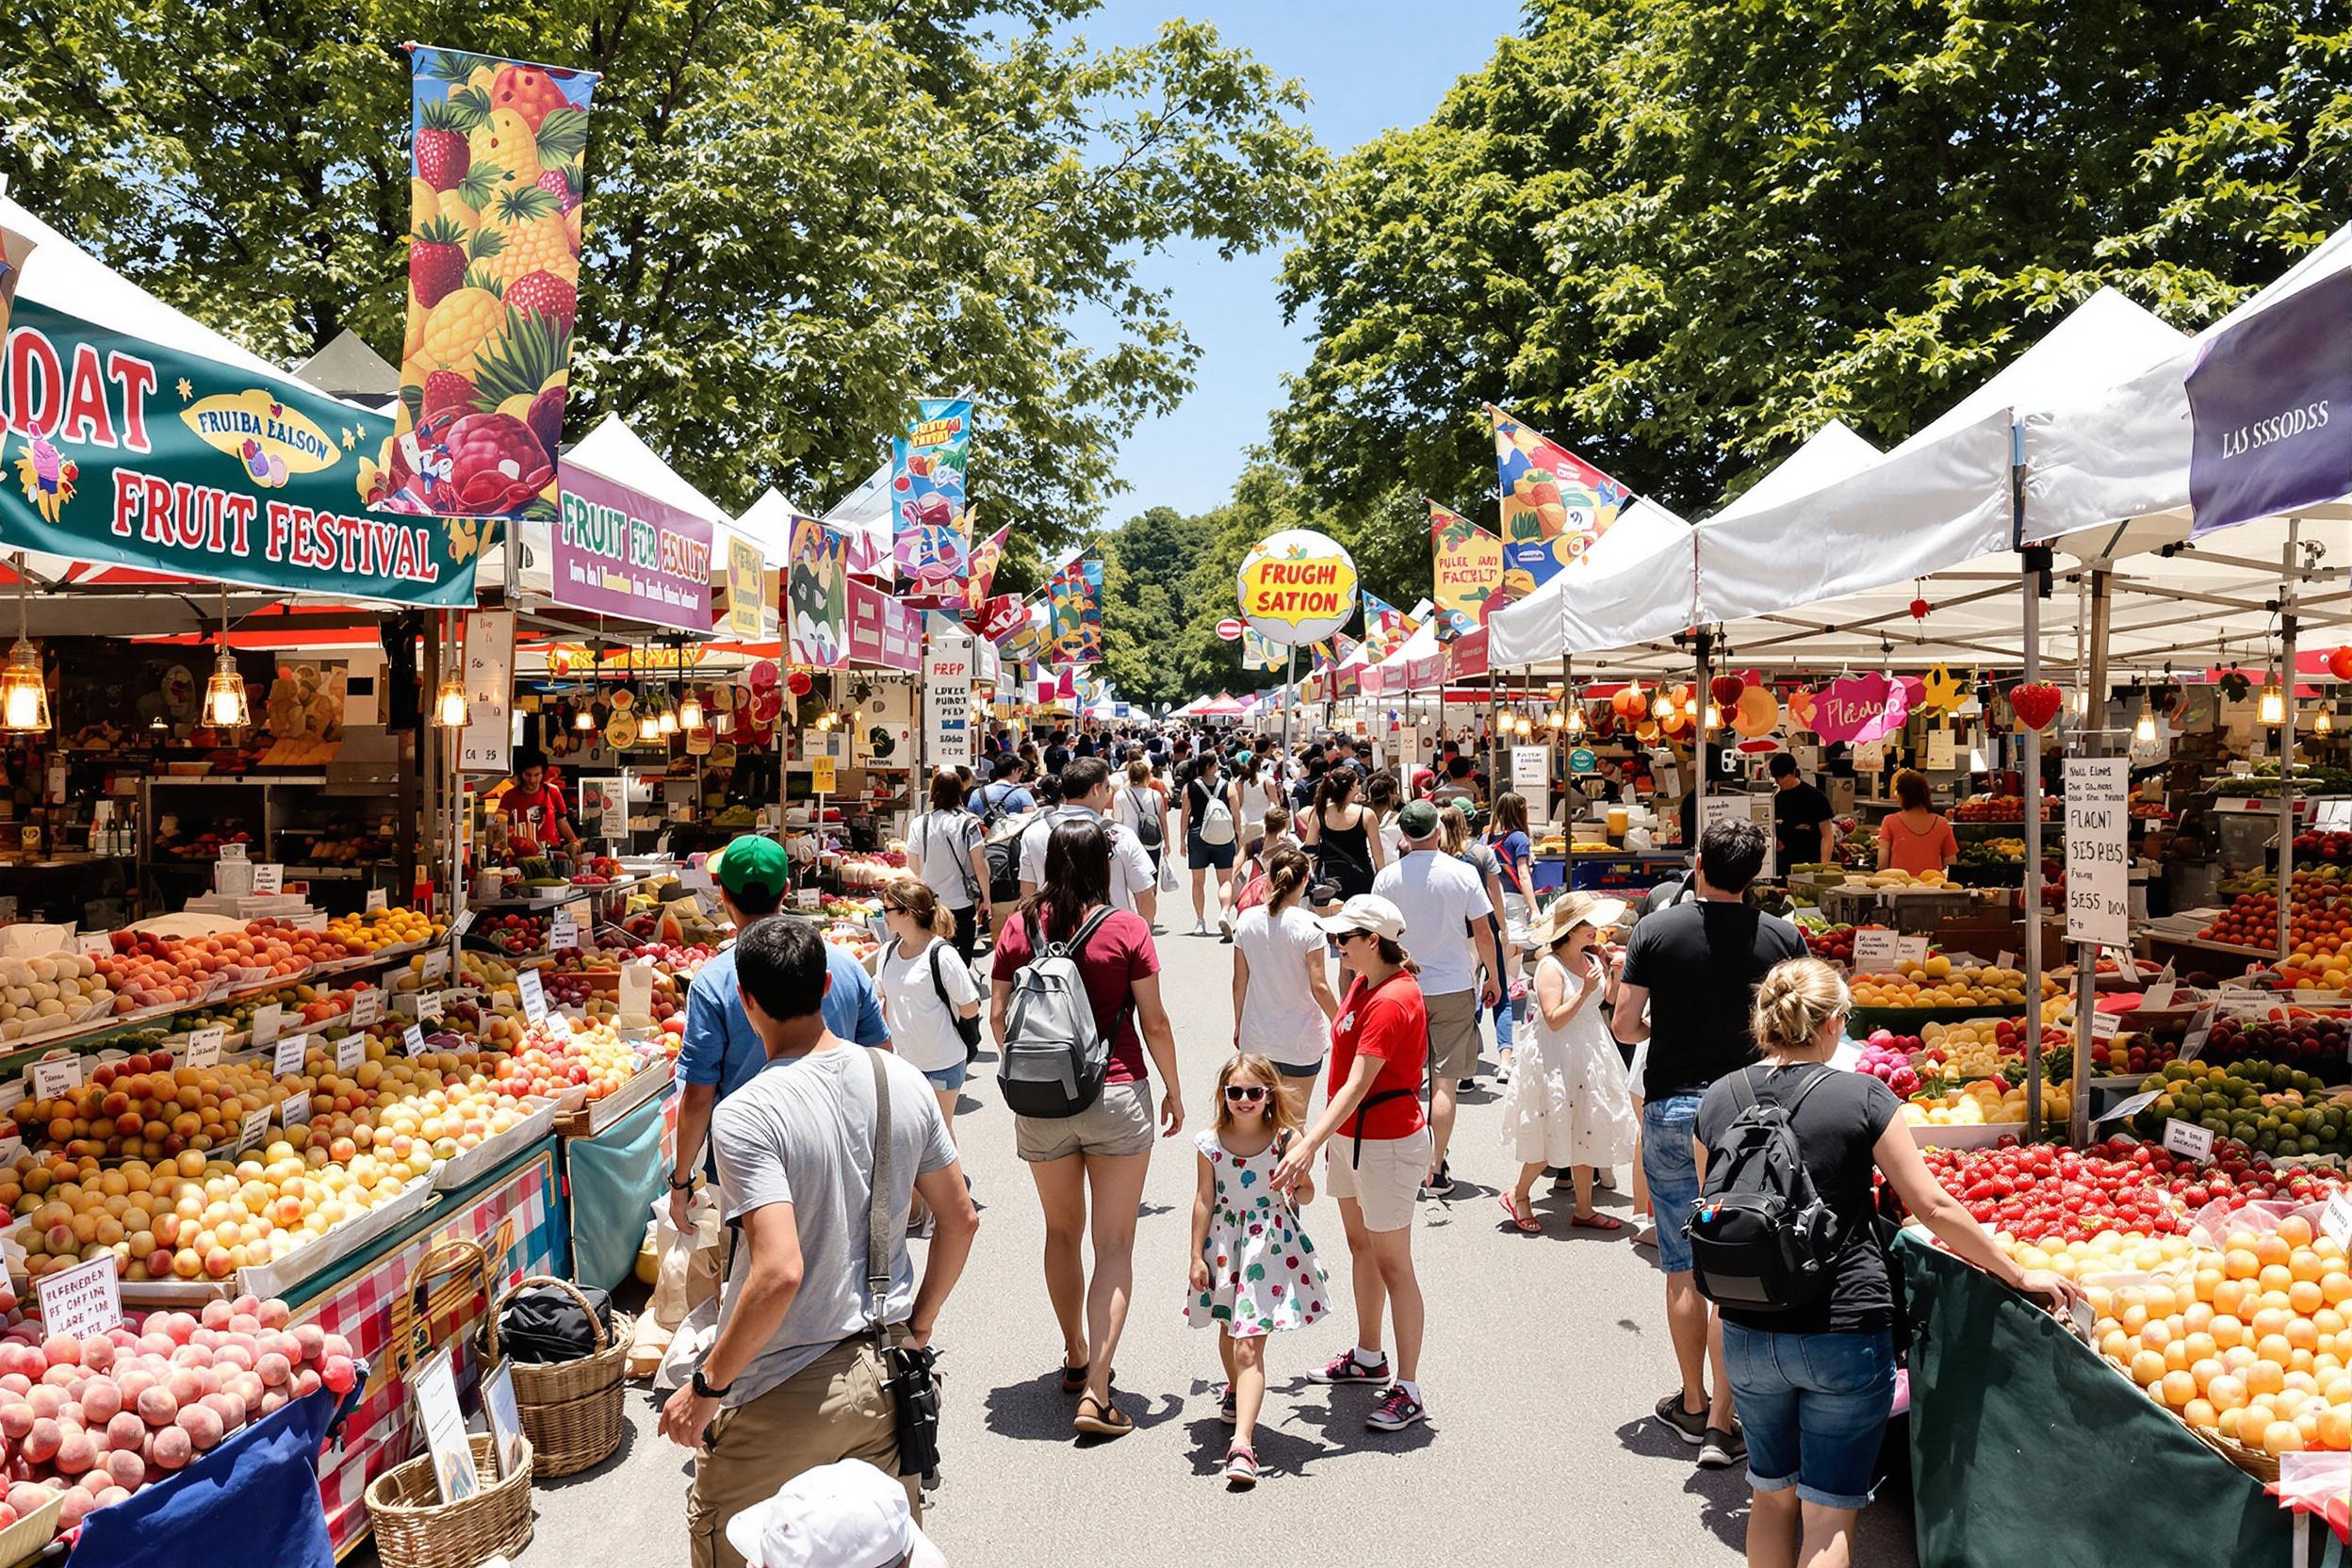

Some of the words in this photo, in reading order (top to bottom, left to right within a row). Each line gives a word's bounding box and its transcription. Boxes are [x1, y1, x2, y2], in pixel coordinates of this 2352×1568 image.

[111, 467, 257, 558] FRUIT
[266, 500, 439, 583] FESTIVAL
[561, 490, 627, 562] FRUIT
[1256, 591, 1339, 612] SATION
